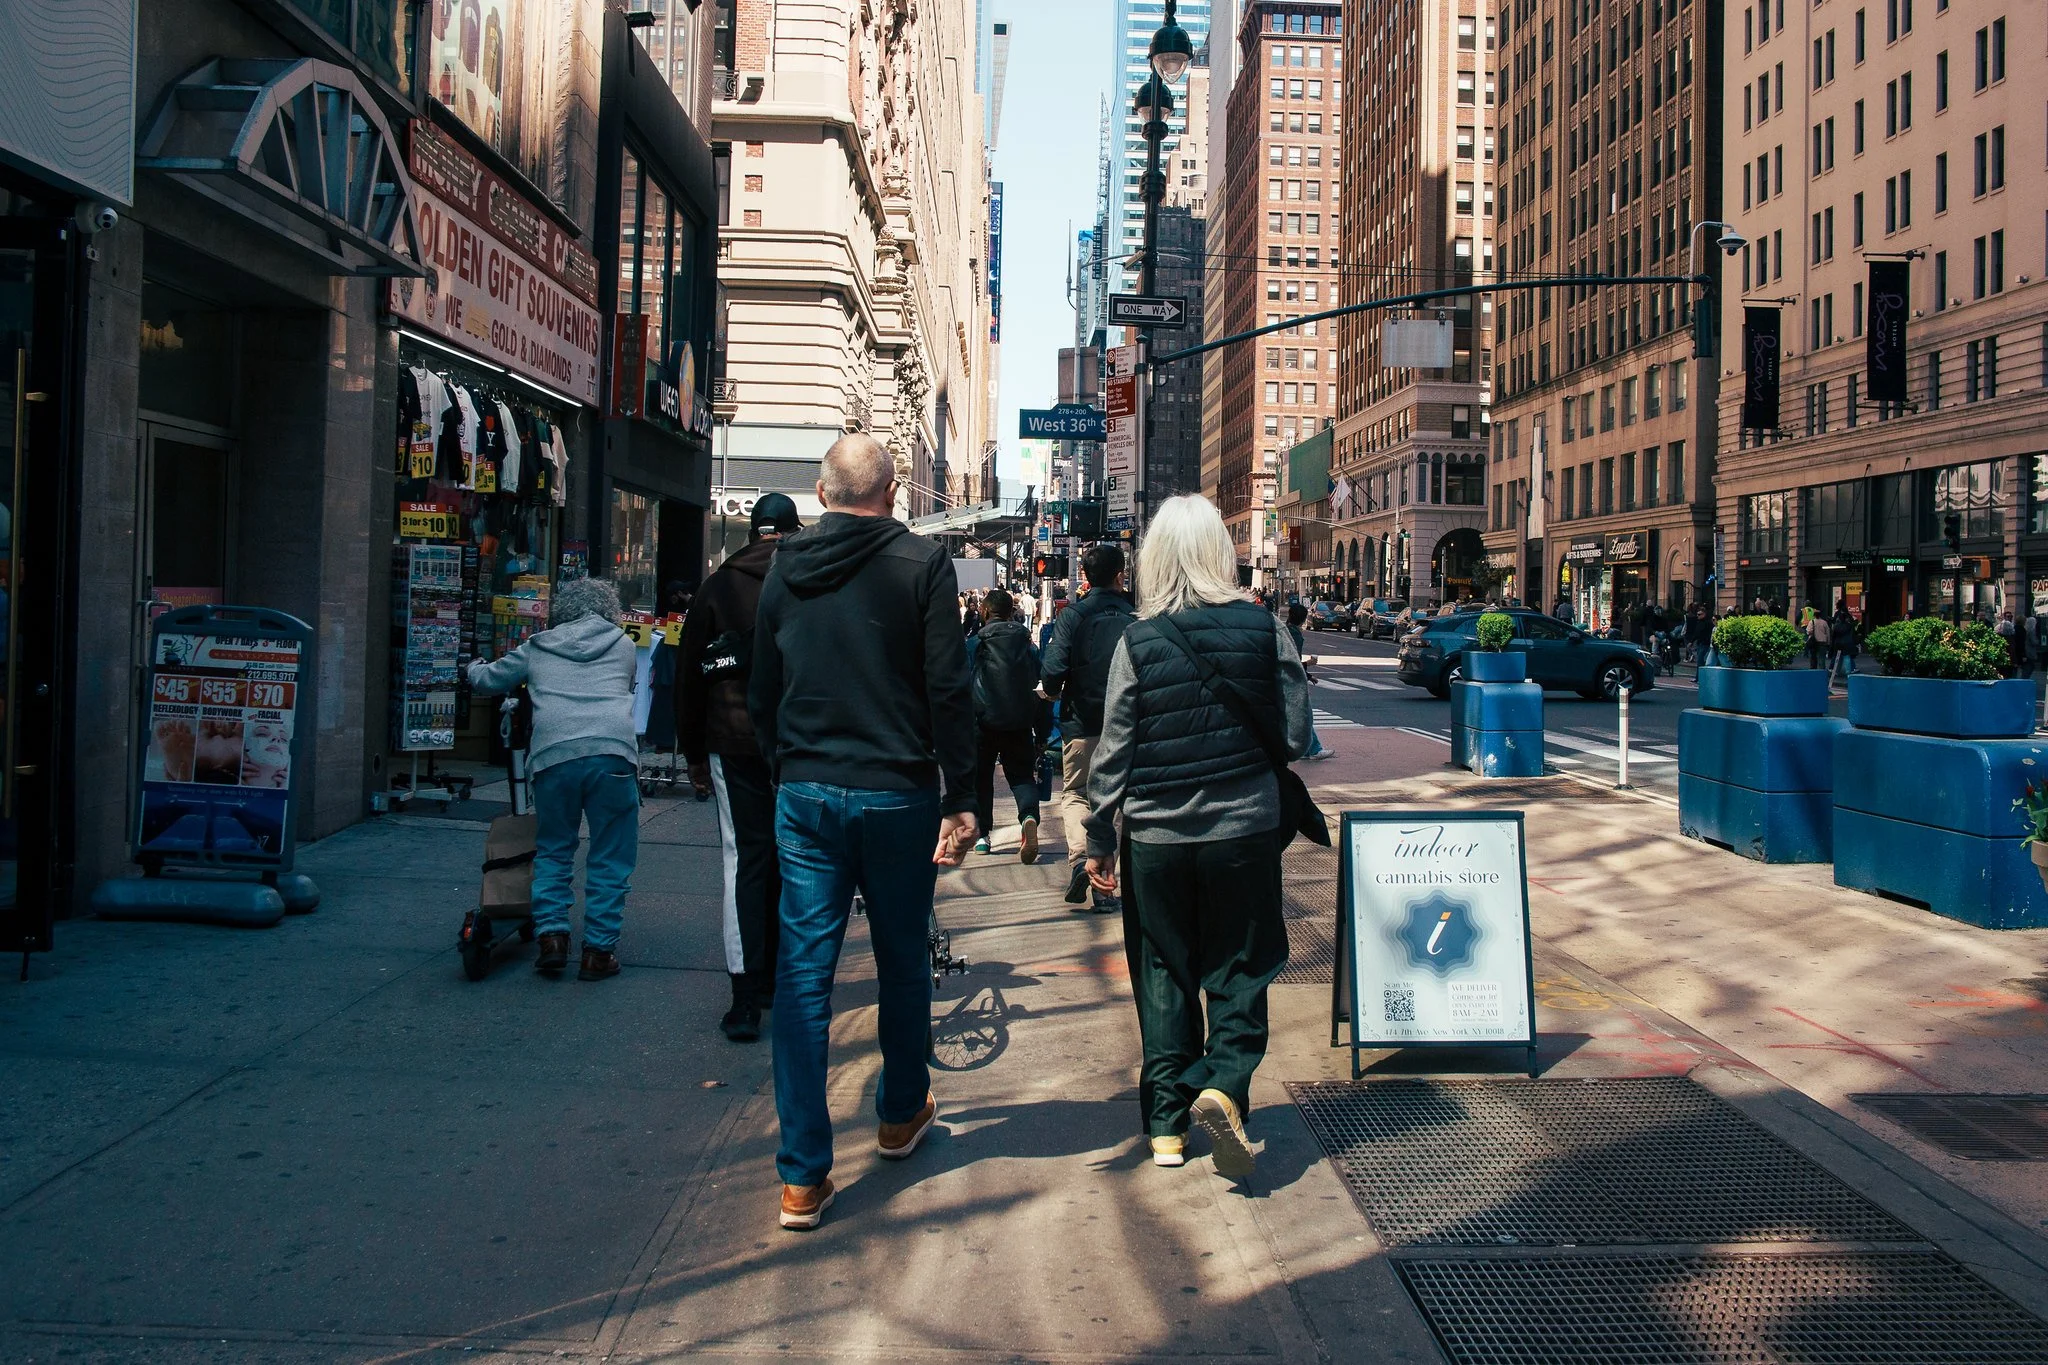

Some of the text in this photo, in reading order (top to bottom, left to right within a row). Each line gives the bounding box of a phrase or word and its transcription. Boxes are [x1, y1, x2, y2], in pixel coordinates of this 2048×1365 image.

[415, 196, 483, 289] OLDEN
[488, 248, 524, 313] GIFT
[527, 274, 598, 358] SOUVENIRS
[1123, 305, 1173, 316] ONE WAY
[445, 292, 572, 385] WE GOLD & DIAMONDS
[1028, 417, 1066, 433] West
[1069, 417, 1096, 433] 36th
[1109, 419, 1115, 432] 3
[1108, 434, 1132, 443] COMMERCIAL
[415, 444, 429, 452] SALE
[412, 455, 432, 475] $10
[1109, 477, 1115, 490] 5
[410, 503, 437, 512] SALE
[402, 517, 445, 533] 3 for $10
[620, 613, 645, 623] SALE
[276, 638, 297, 649] FLOOR
[247, 670, 295, 682] 212.695.9717
[156, 677, 284, 707] $45 $55 $70
[153, 704, 199, 715] REFLEXOLOGY
[202, 707, 243, 718] BODYWORK
[257, 710, 281, 720] FACIAL
[1375, 867, 1500, 885] cannabis store
[1452, 993, 1474, 1001] Come
[1433, 1028, 1448, 1036] New
[1451, 1028, 1468, 1036] York
[1472, 1028, 1482, 1036] NY
